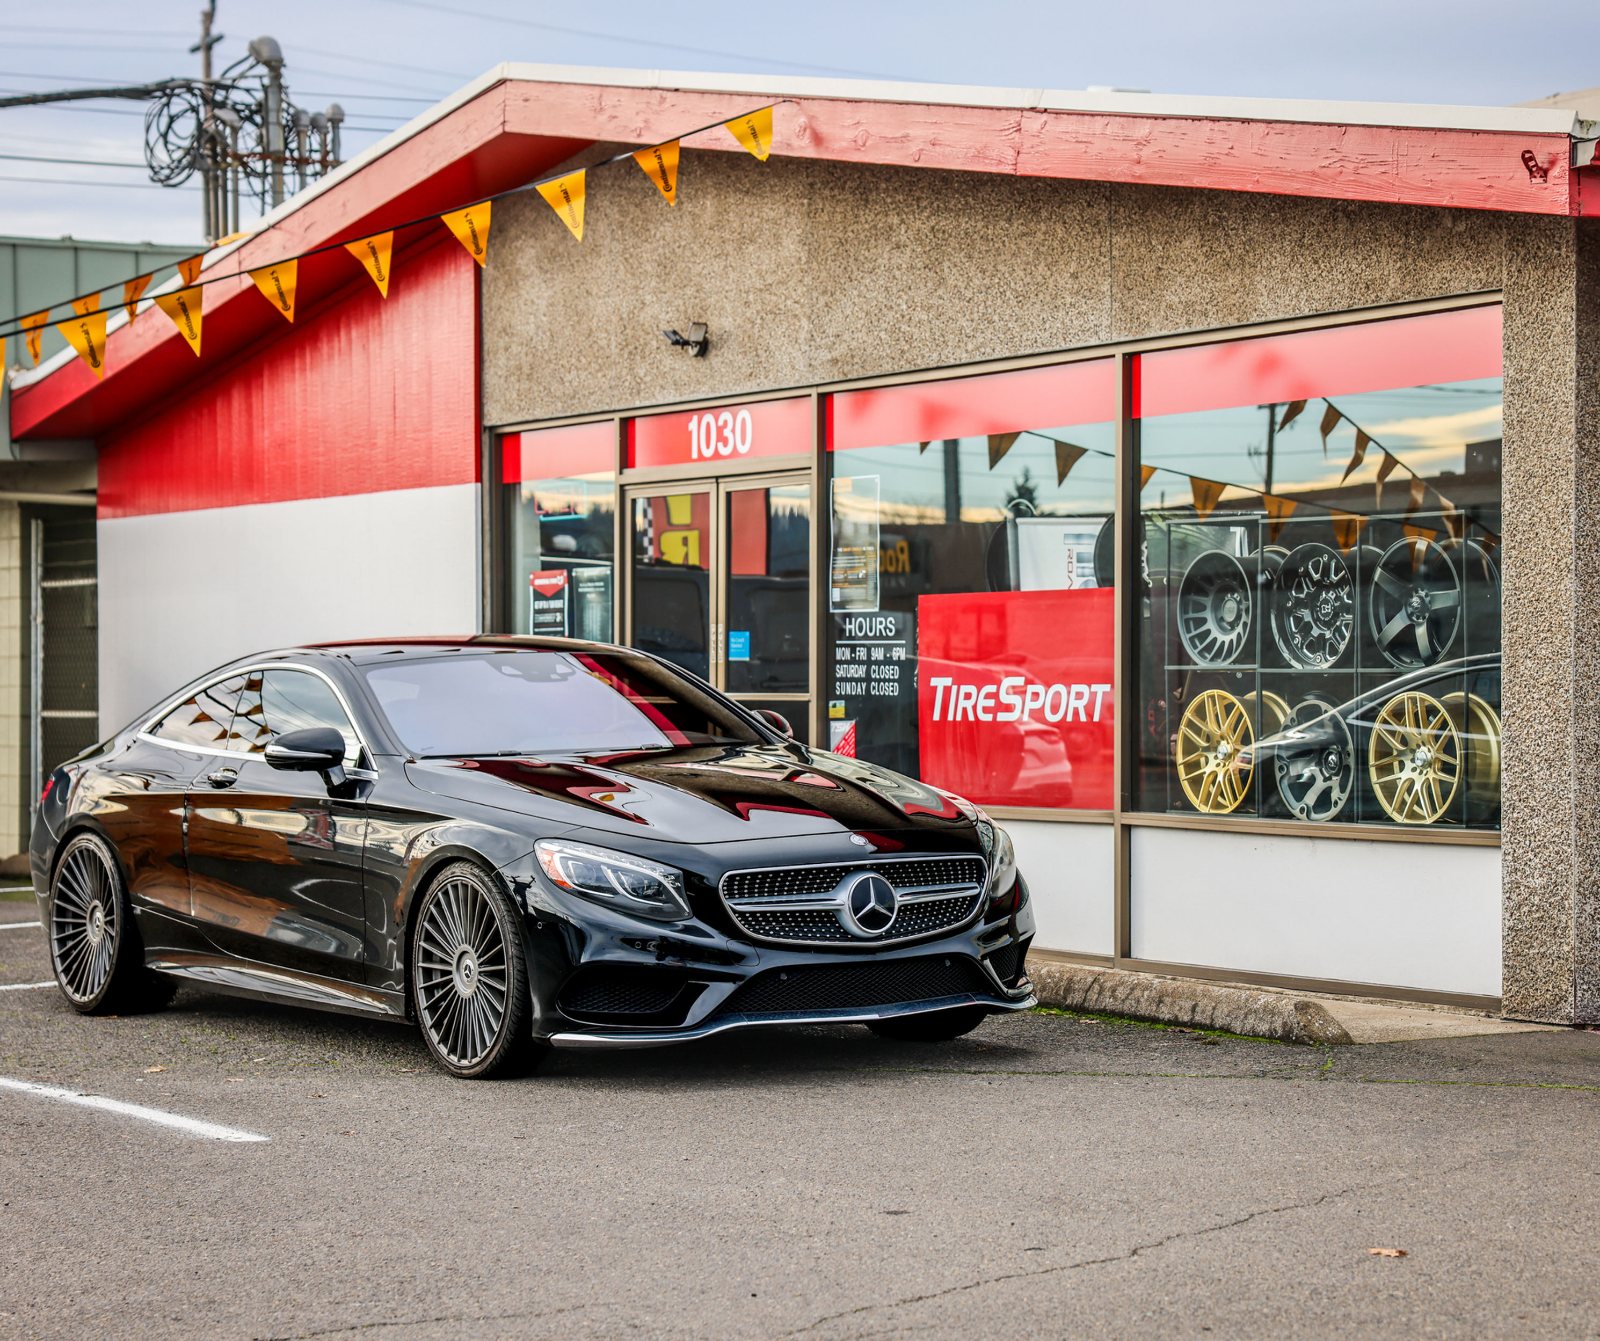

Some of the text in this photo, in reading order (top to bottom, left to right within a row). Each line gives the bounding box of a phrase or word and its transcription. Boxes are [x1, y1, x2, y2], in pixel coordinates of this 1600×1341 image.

[688, 408, 752, 460] 1030
[845, 616, 896, 637] HOURS
[836, 647, 851, 660] MON
[856, 647, 867, 660] FRI
[871, 647, 884, 660] 9AM
[892, 647, 906, 660] 6PM
[835, 664, 900, 679] SATURDAY CLOSED
[835, 681, 899, 696] SUNDAY CLOSED
